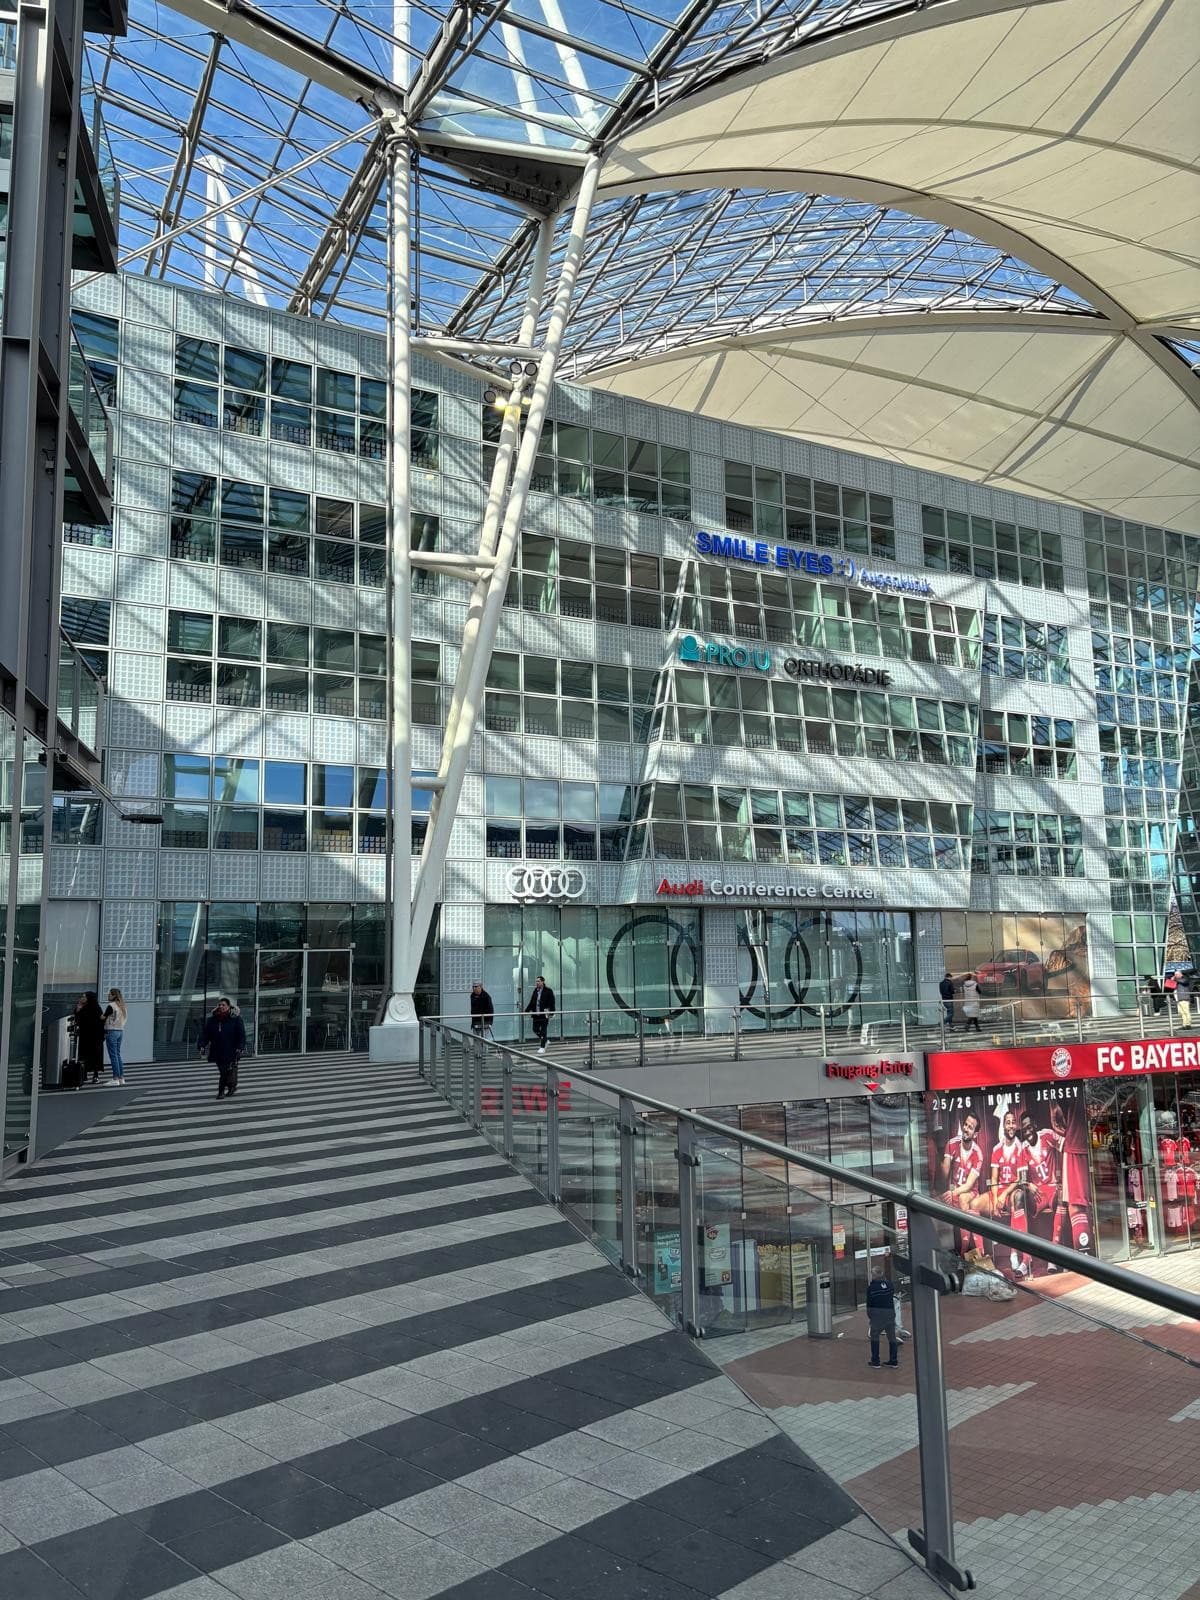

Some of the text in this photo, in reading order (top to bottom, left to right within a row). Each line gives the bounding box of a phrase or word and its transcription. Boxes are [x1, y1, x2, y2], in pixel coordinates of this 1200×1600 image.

[696, 532, 769, 564] SMILE
[775, 545, 834, 575] EYES
[783, 657, 892, 686] ORTHOPÄDIE
[656, 879, 878, 899] Audi Conference Center
[1097, 1046, 1125, 1073] FC
[932, 1086, 1078, 1112] 25/26 HOME JERSEY
